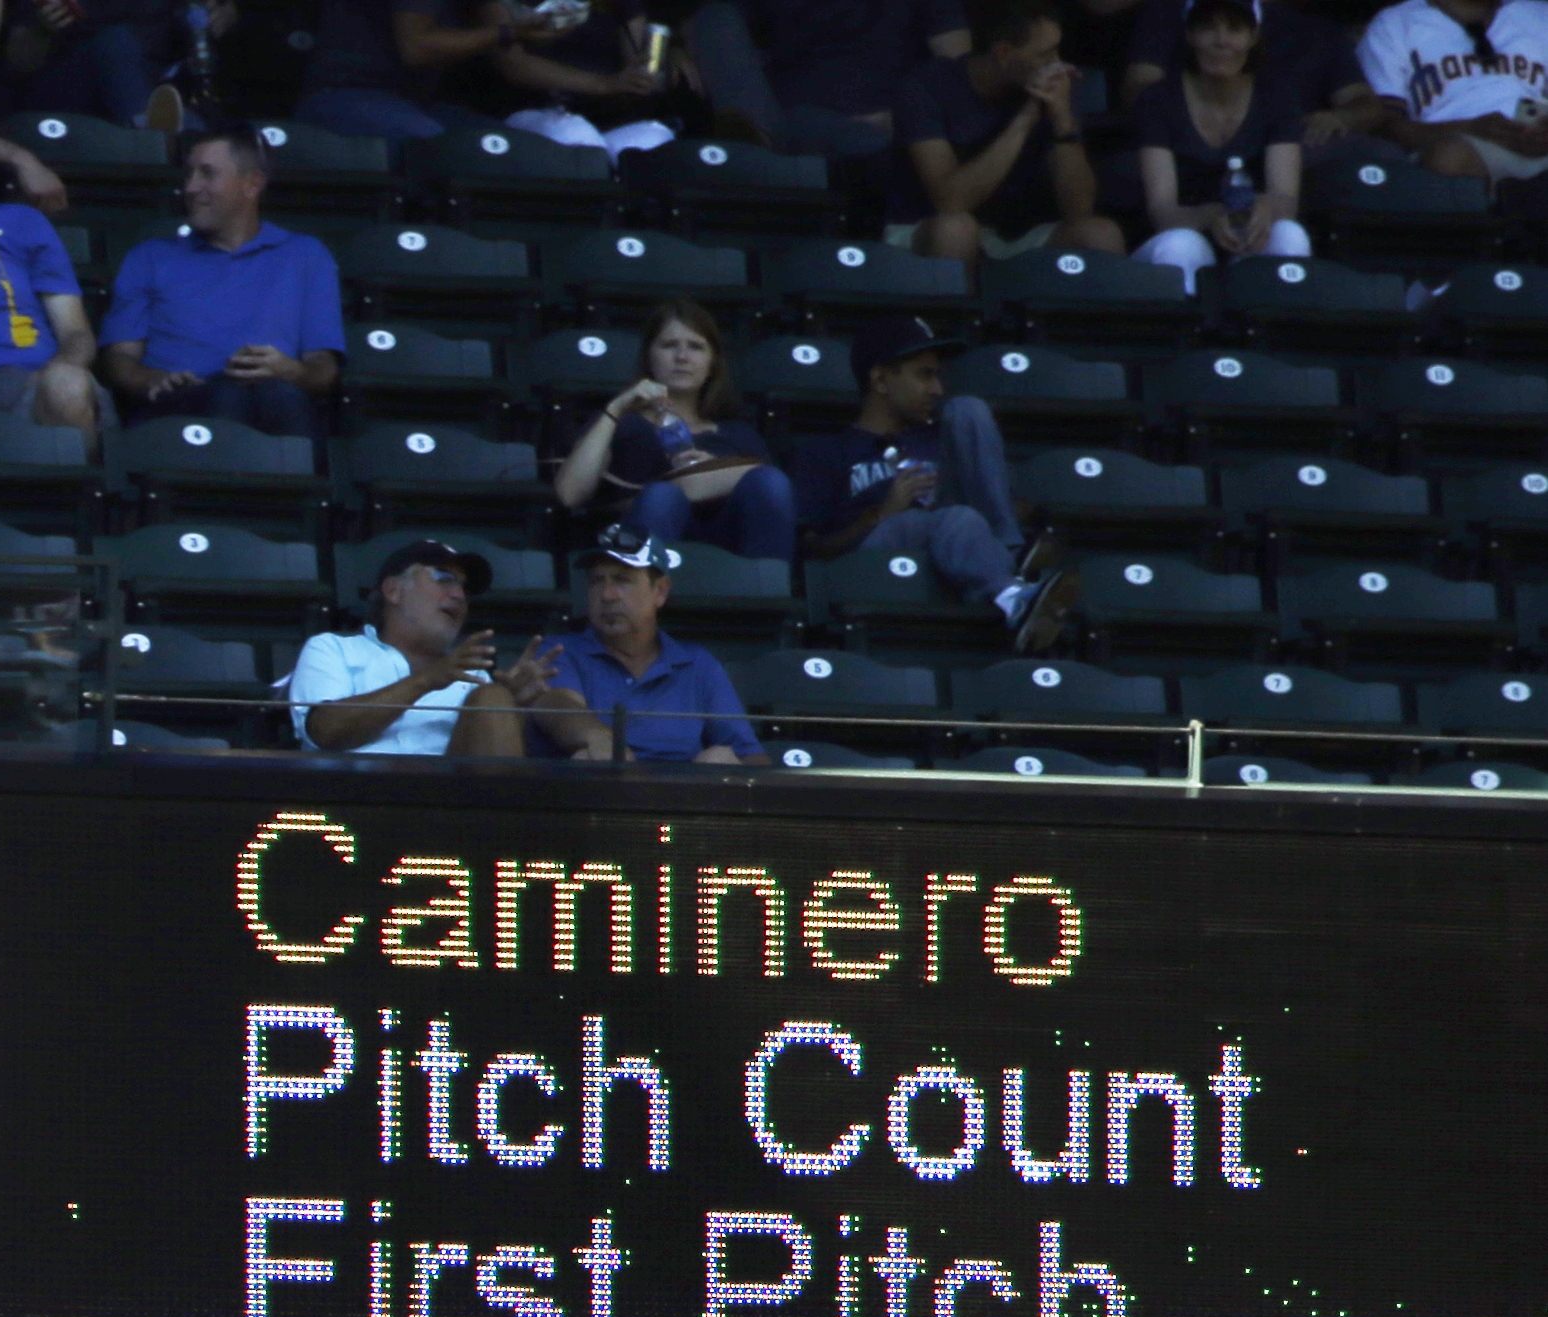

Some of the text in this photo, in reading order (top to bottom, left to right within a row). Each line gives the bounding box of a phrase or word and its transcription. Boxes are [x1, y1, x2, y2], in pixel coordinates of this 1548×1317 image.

[235, 810, 1084, 987] Caminero
[241, 1003, 1264, 1189] Pitch Count
